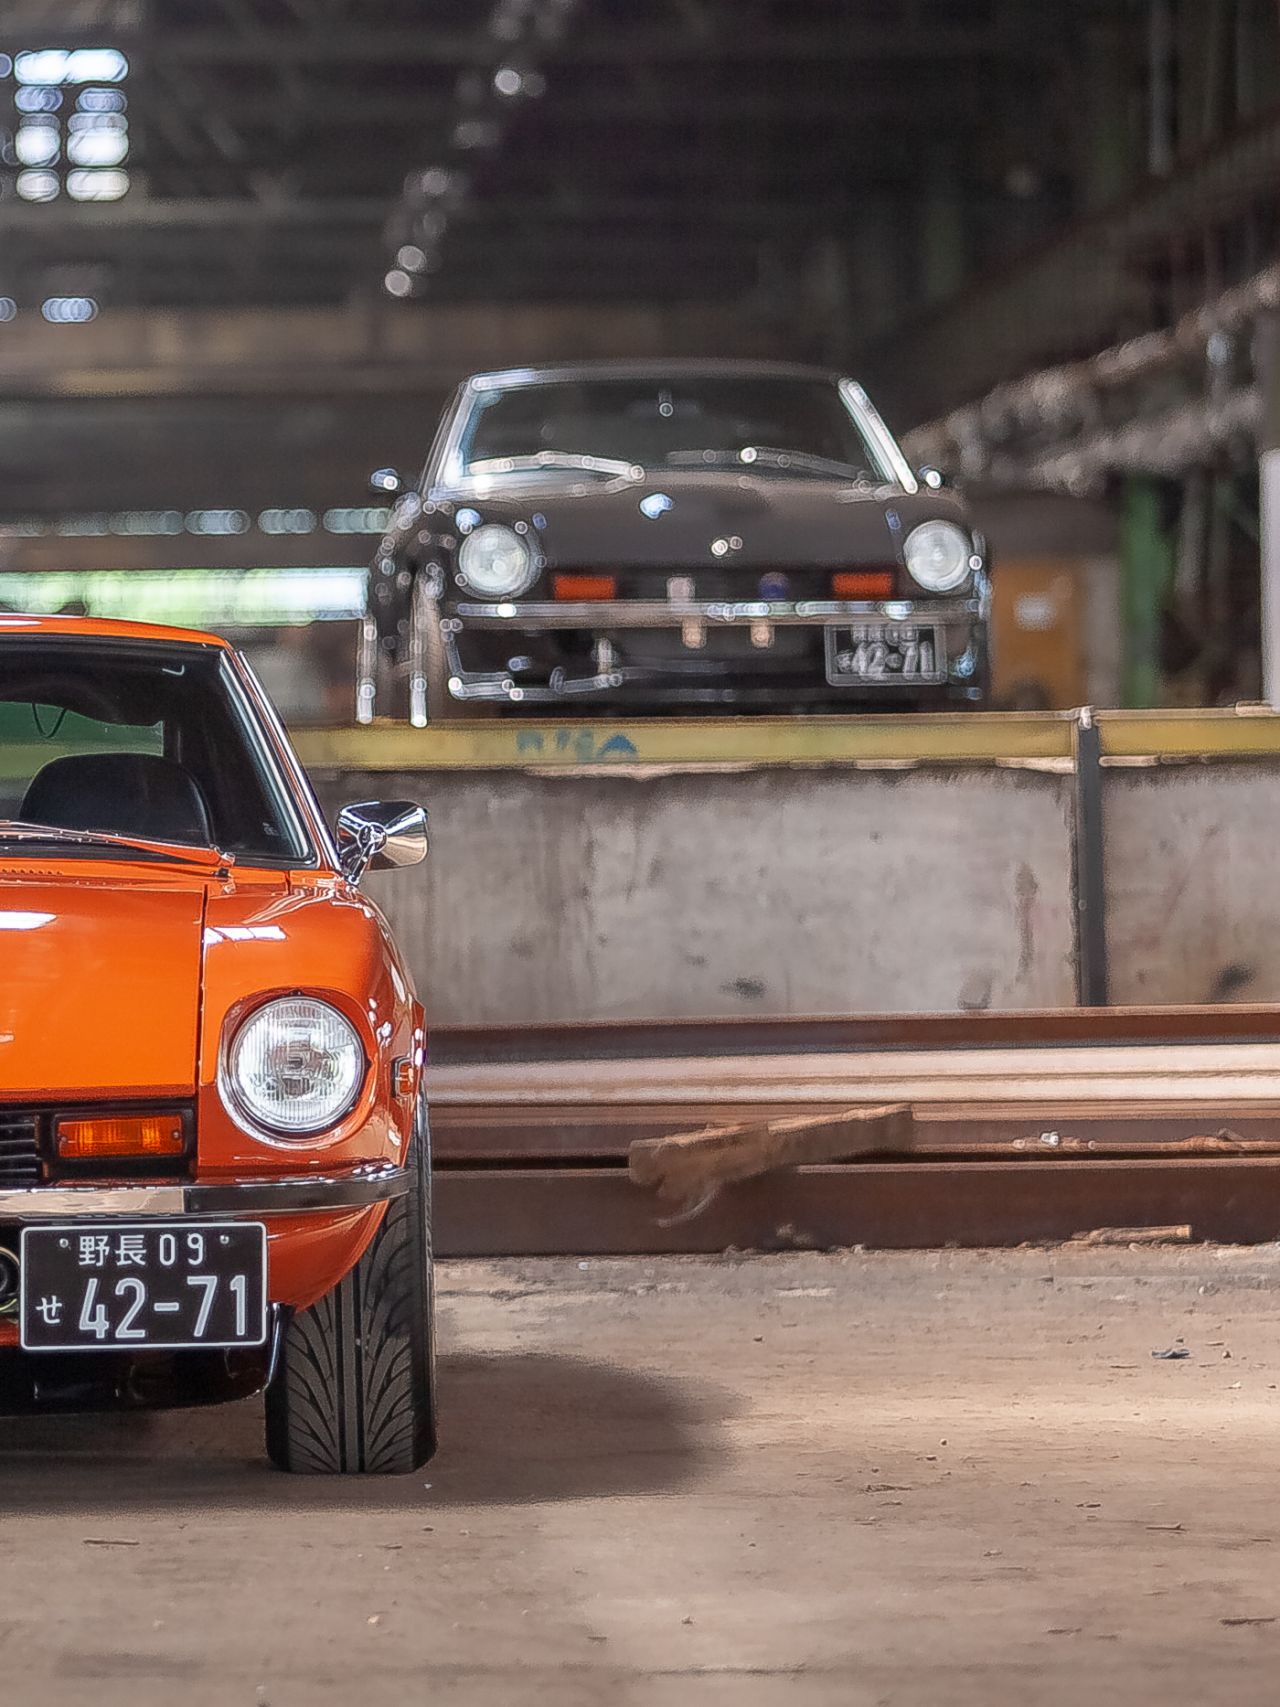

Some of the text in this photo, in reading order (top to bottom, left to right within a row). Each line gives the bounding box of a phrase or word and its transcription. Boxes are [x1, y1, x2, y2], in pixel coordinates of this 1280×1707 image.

[158, 1233, 204, 1265] 09
[35, 1274, 246, 1339] せ 42-71
